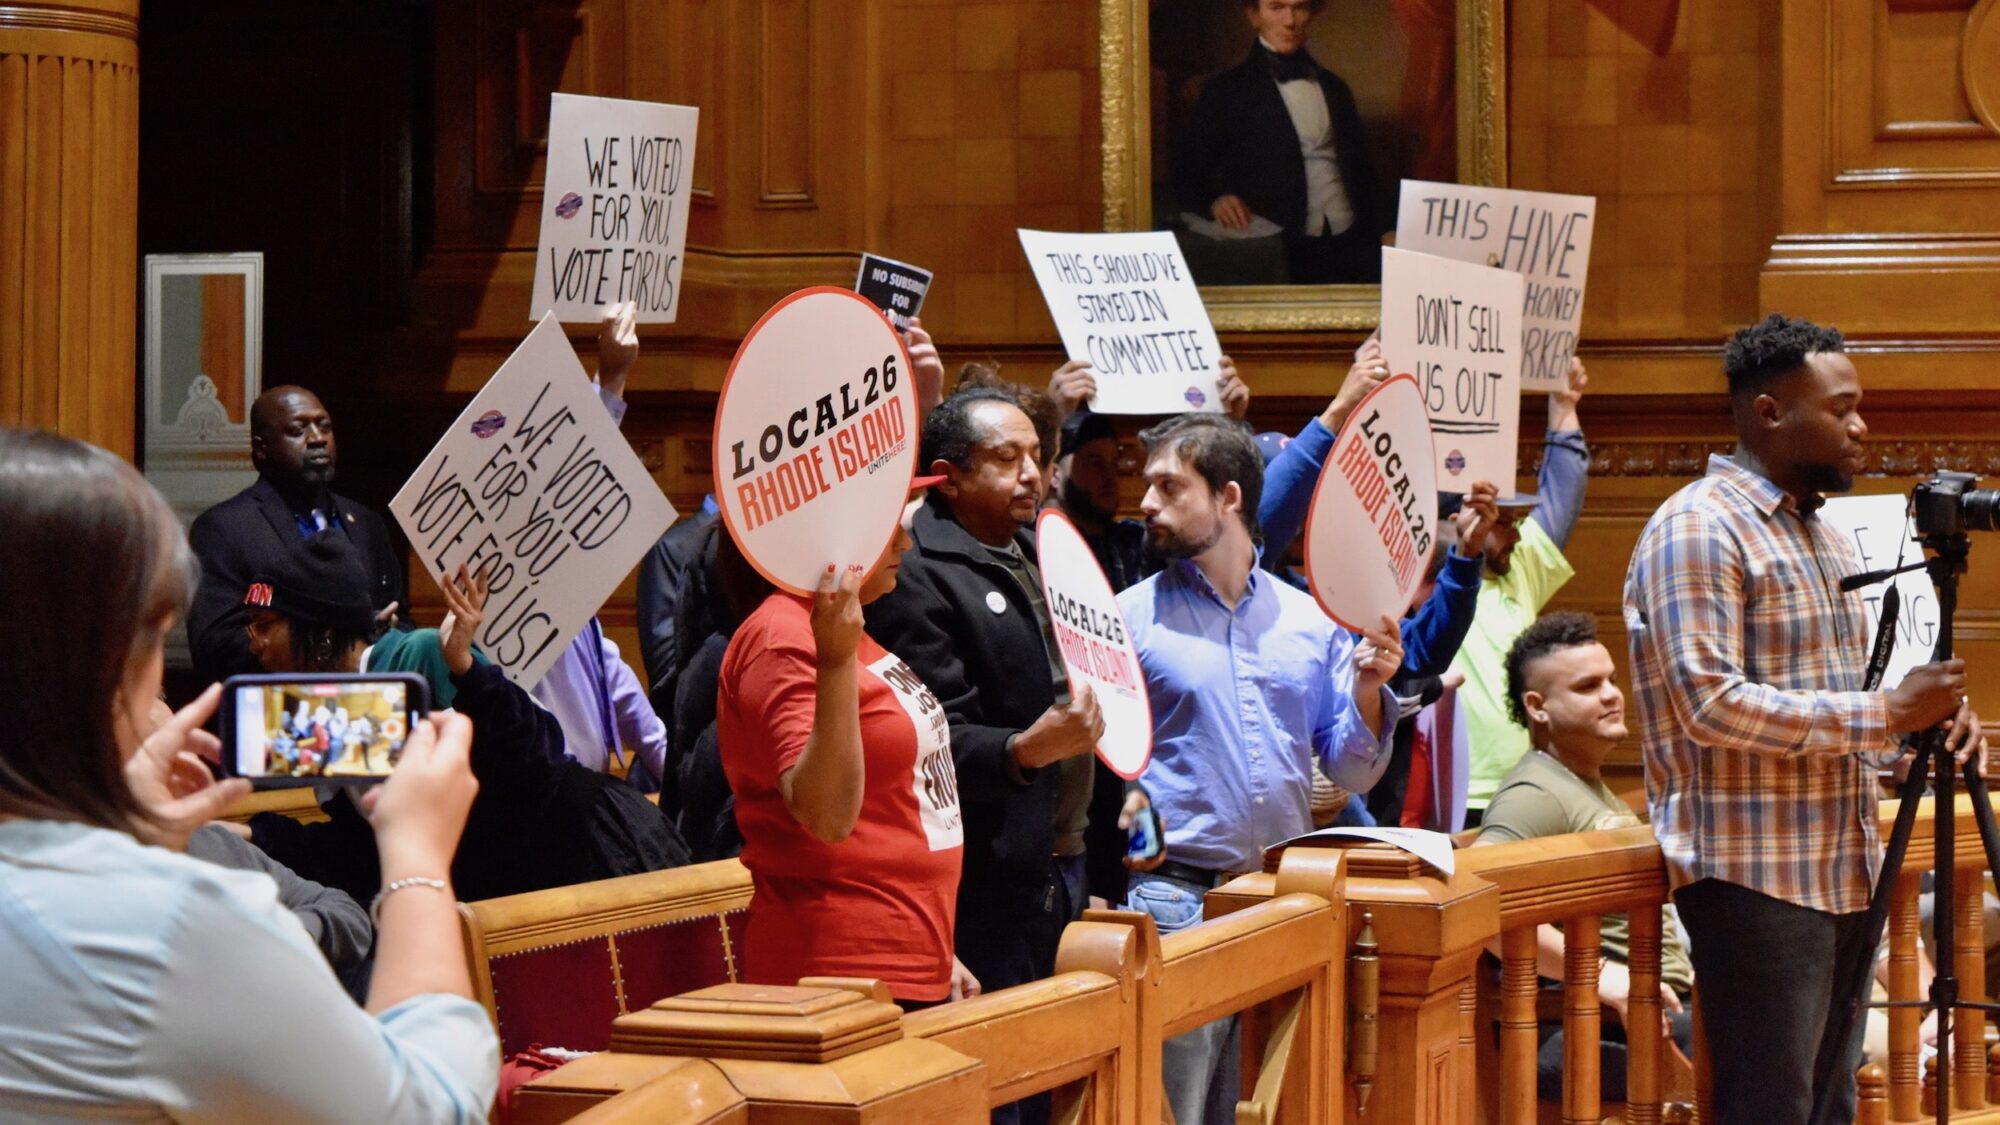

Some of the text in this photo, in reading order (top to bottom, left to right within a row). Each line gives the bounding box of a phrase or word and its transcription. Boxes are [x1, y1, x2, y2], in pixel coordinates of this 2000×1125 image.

[584, 135, 683, 196] WE VOTED
[590, 193, 631, 242] FOR
[638, 195, 673, 247] YOU,
[1422, 198, 1588, 278] THIS HIVE
[551, 247, 613, 305] VOTE
[872, 267, 888, 283] NO
[1046, 253, 1093, 285] THIS
[891, 293, 910, 310] FOR
[1077, 288, 1169, 324] STAYED IN
[1416, 294, 1505, 354] DON'T SELL
[1086, 329, 1210, 376] COMMITTEE
[1416, 362, 1503, 420] US OUT
[474, 443, 527, 522] FOR
[513, 381, 632, 550] WE VOTED
[736, 395, 906, 532] RHODE ISLAND
[1336, 432, 1418, 594] RHODE ISLAND
[410, 455, 484, 572] VOTE
[483, 585, 559, 680] US!
[1056, 621, 1137, 691] RHODE ISLAND
[915, 687, 942, 715] JO
